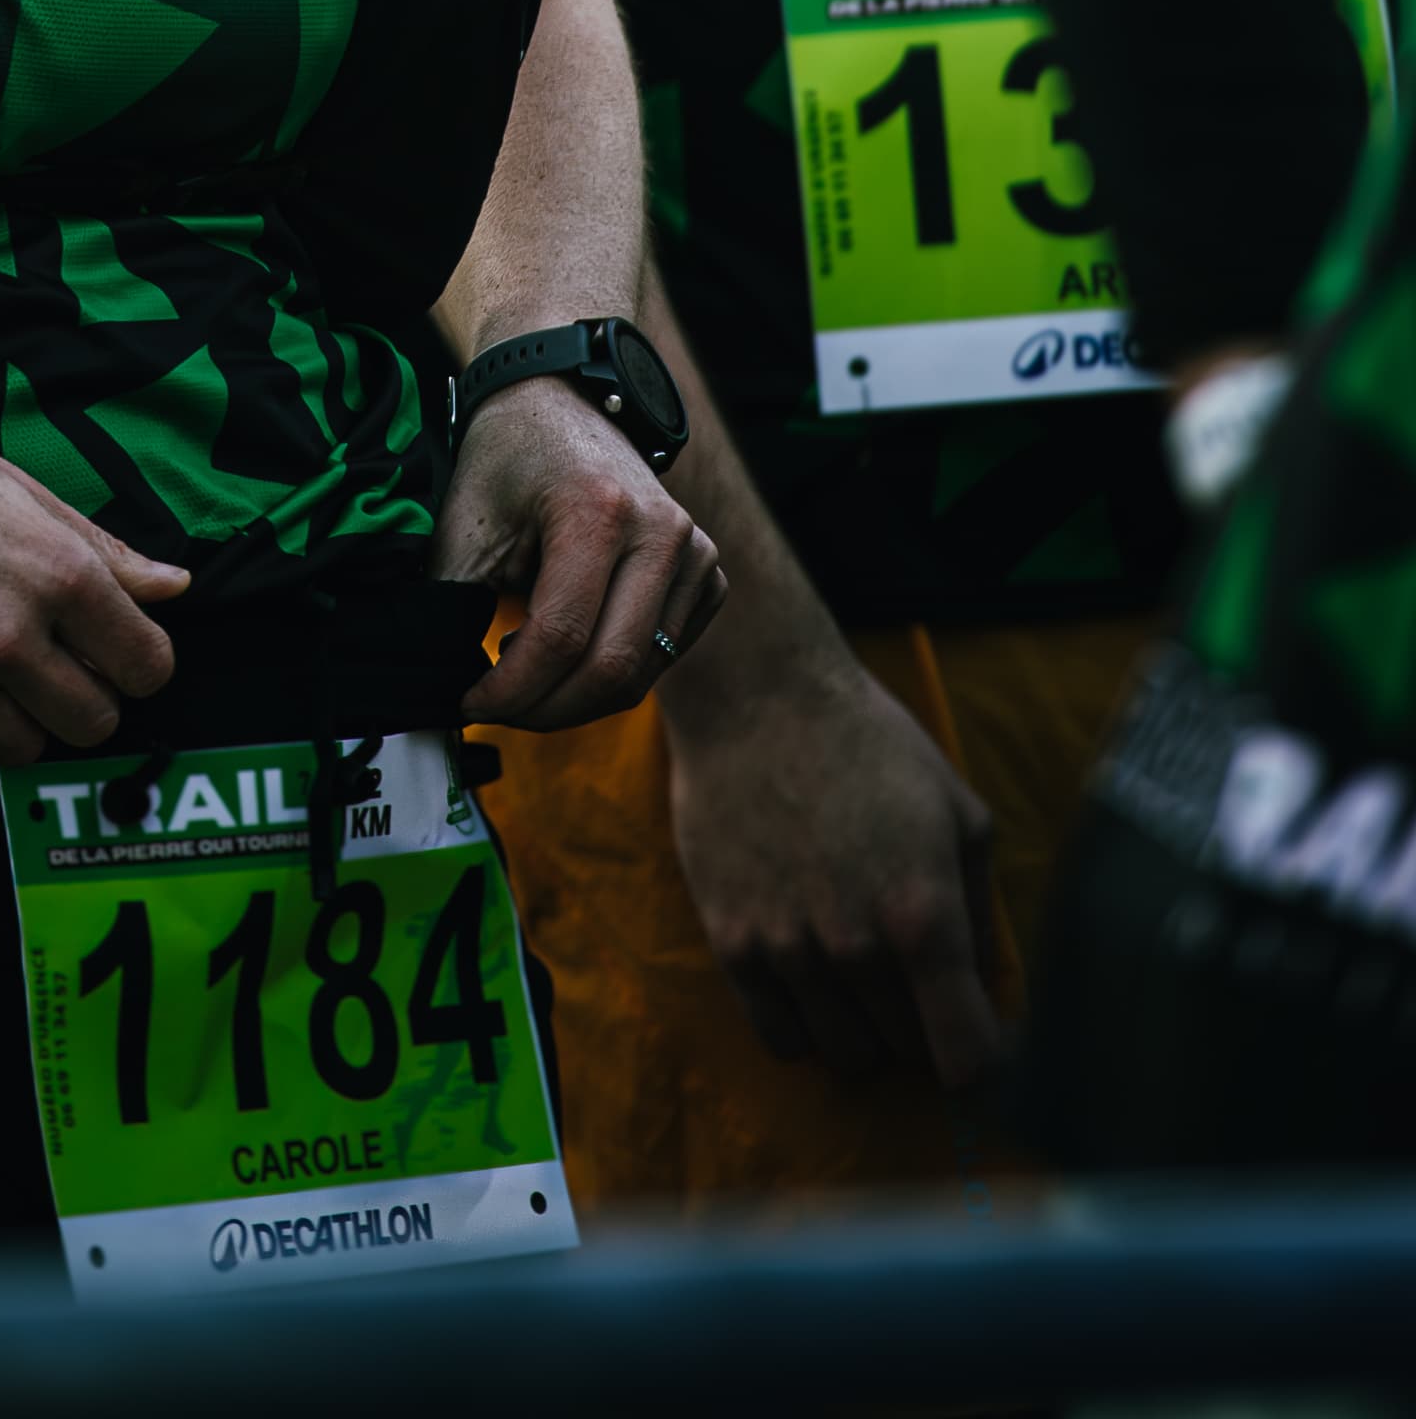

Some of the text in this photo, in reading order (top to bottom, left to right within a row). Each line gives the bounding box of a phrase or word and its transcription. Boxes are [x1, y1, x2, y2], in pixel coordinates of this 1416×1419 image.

[854, 35, 1114, 248] 13
[1059, 262, 1119, 303] AR
[1074, 330, 1142, 370] DEC
[351, 805, 391, 839] KM
[48, 831, 311, 866] DE LA PIERRE QUI TOURN
[78, 866, 508, 1125] 1184
[233, 1130, 384, 1185] CAROLE
[252, 1203, 433, 1260] DECATHLON
